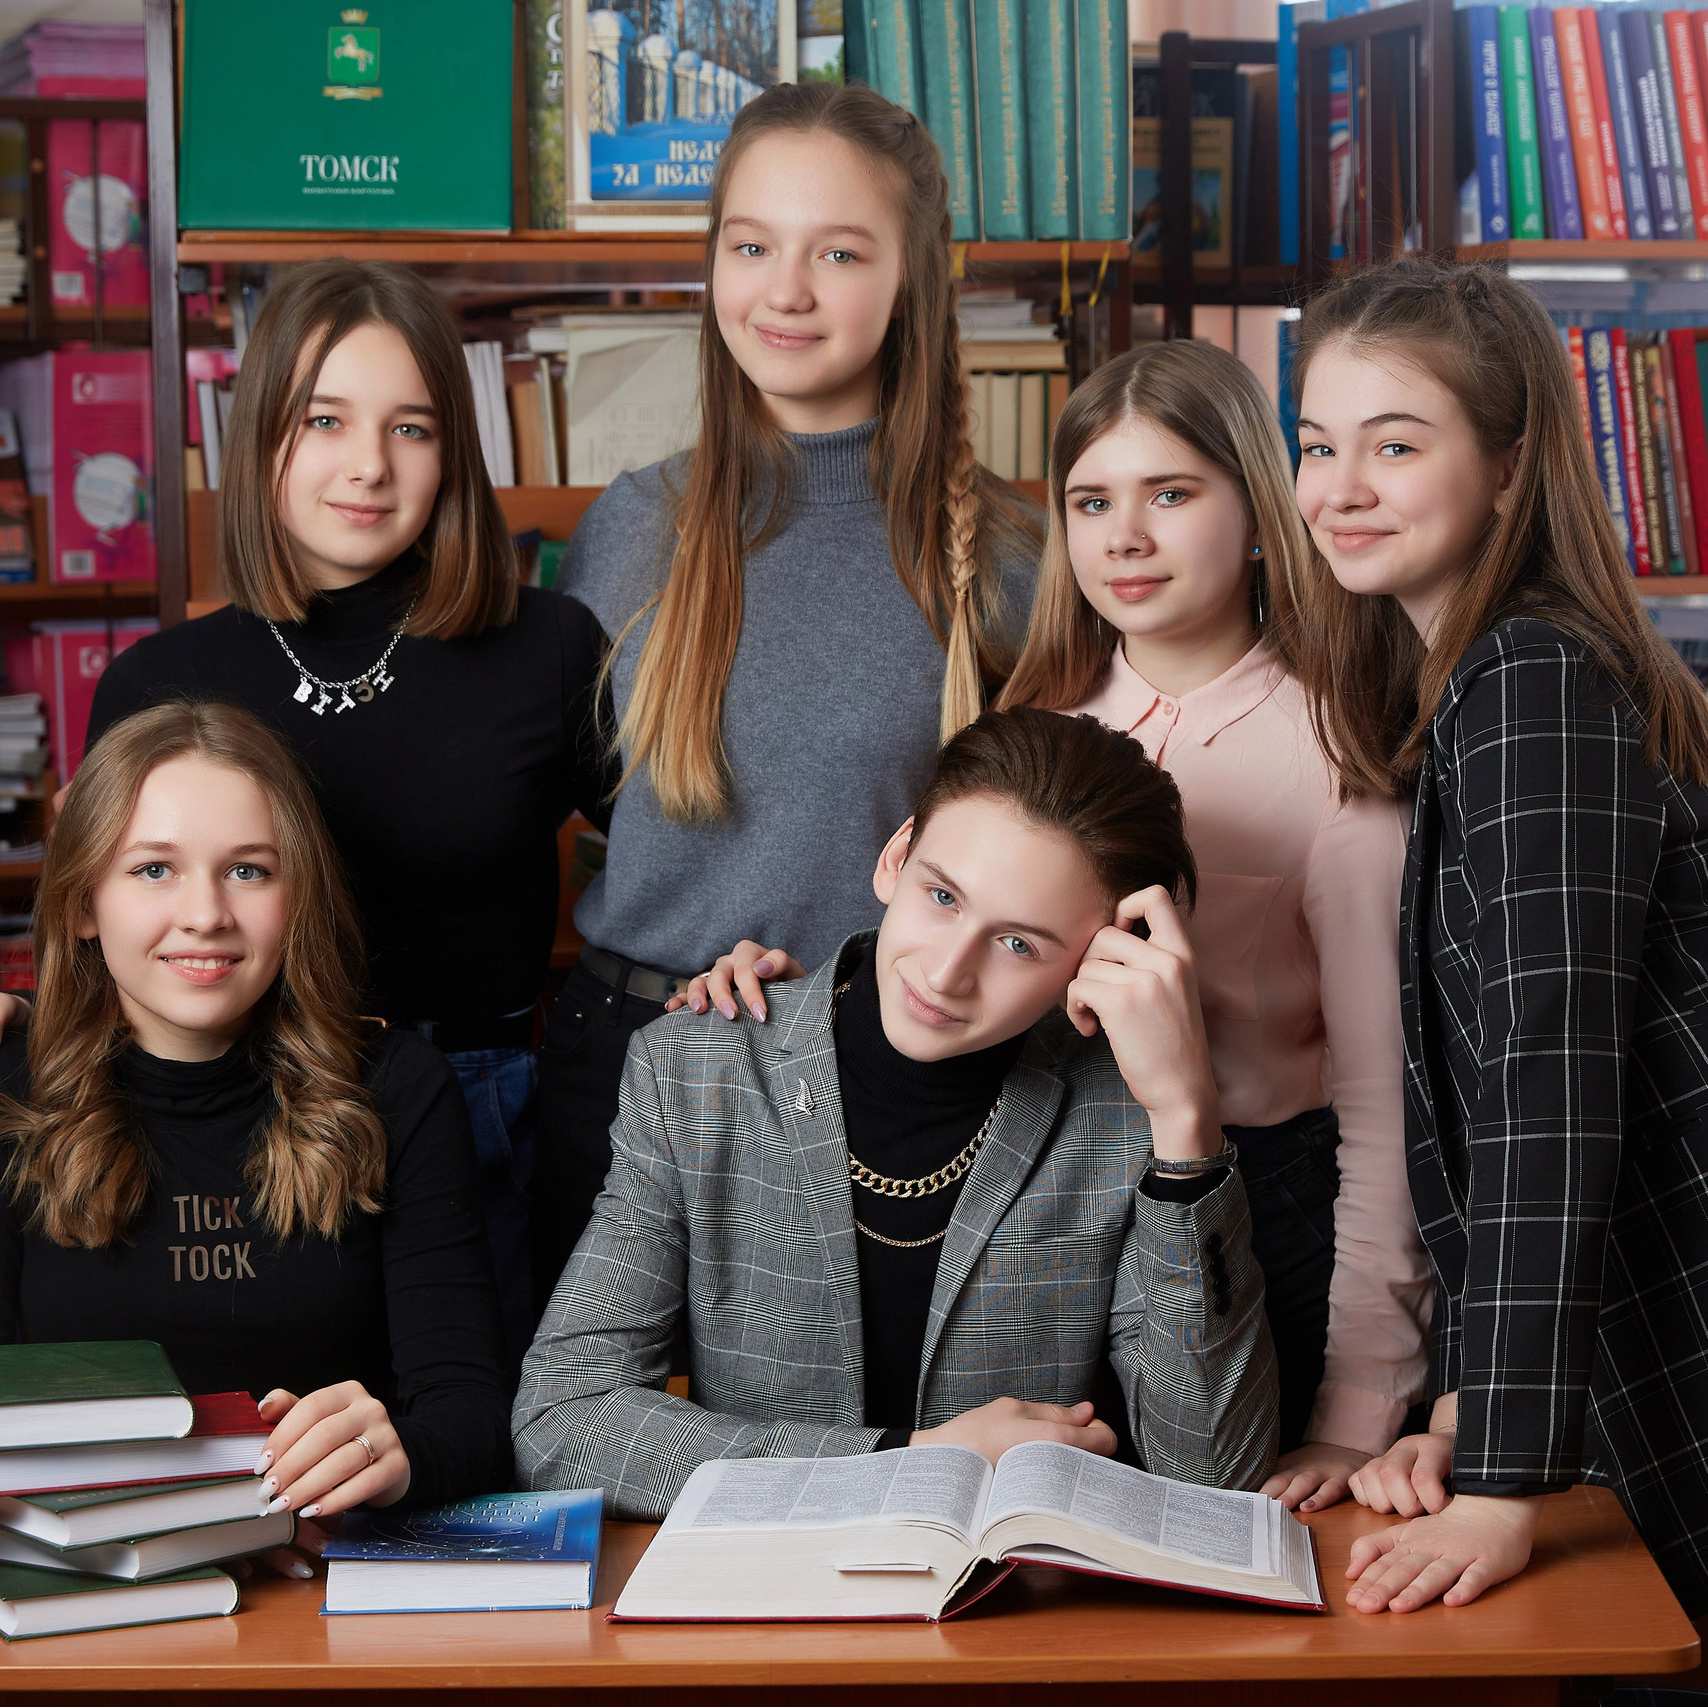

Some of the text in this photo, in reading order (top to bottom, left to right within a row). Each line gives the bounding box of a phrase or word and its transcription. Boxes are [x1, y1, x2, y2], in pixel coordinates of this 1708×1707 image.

[299, 154, 400, 182] ТОМСК
[612, 163, 640, 186] ЗА
[172, 1194, 244, 1233] TICK
[168, 1241, 257, 1282] TOCK
